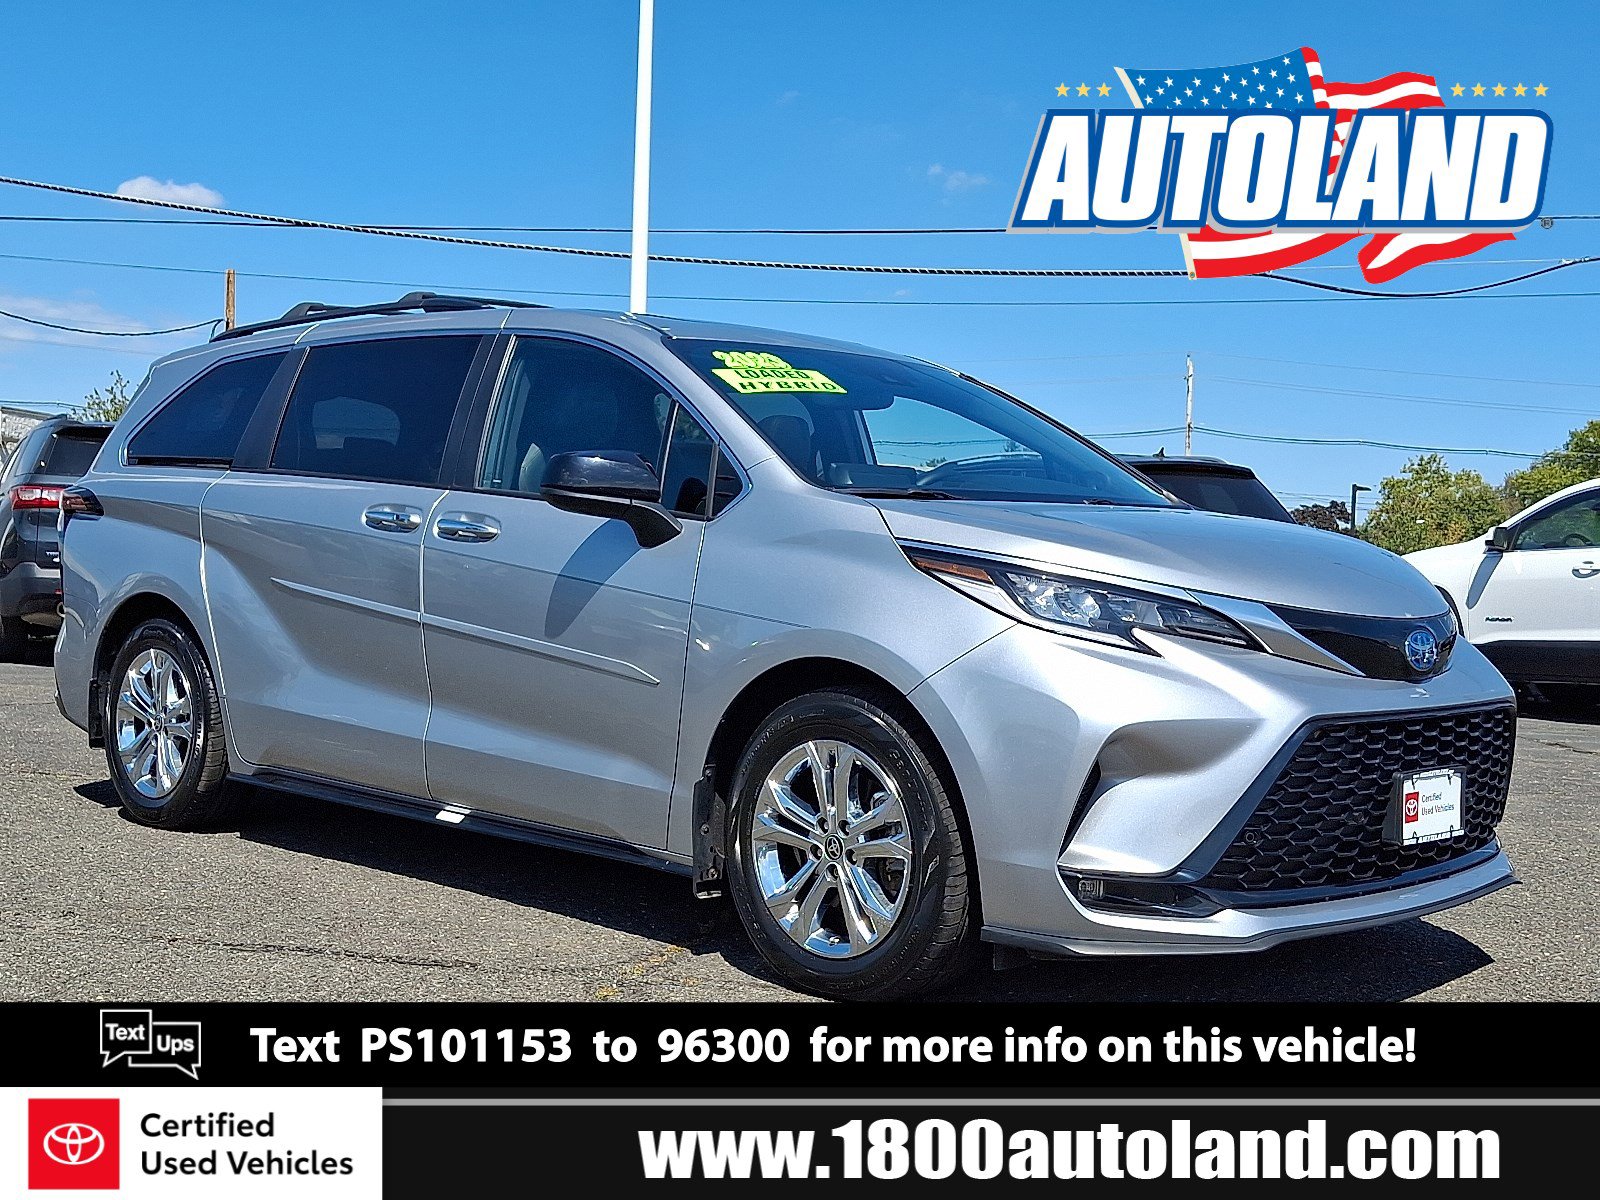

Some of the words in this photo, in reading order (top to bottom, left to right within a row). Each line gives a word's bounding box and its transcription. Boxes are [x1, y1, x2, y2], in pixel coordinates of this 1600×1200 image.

[733, 369, 811, 380] LOADED
[738, 380, 838, 391] HYBRID
[1421, 792, 1443, 803] Certified
[1421, 806, 1434, 816] Used
[1434, 803, 1455, 813] Vehicles
